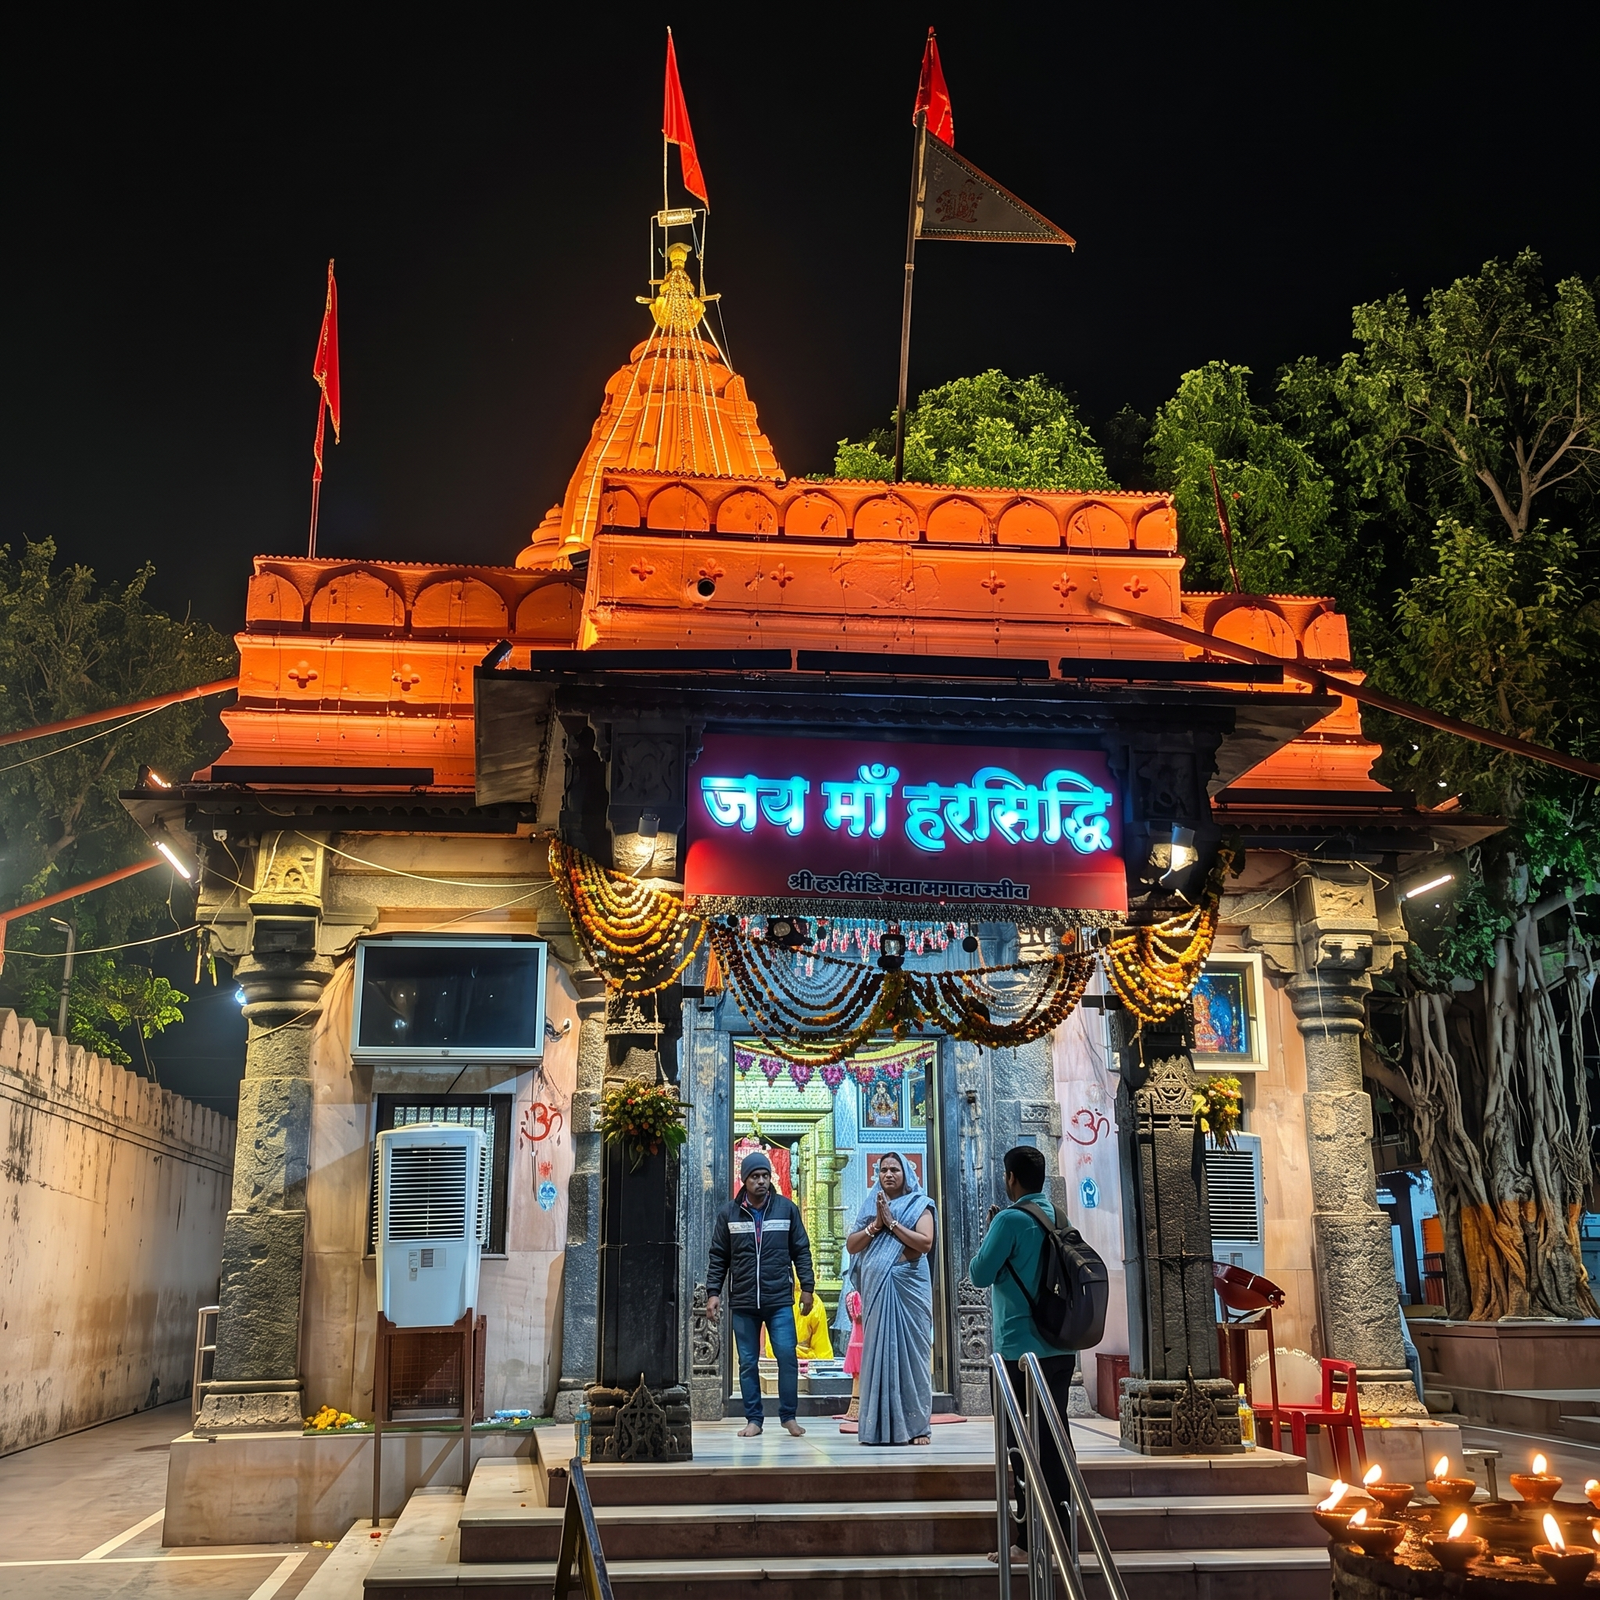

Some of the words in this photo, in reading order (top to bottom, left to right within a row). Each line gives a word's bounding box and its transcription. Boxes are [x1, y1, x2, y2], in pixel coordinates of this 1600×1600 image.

[701, 774, 809, 837] जय
[820, 763, 900, 838] माँ
[902, 767, 1112, 854] हरसिद्धि
[787, 869, 813, 892] श्री
